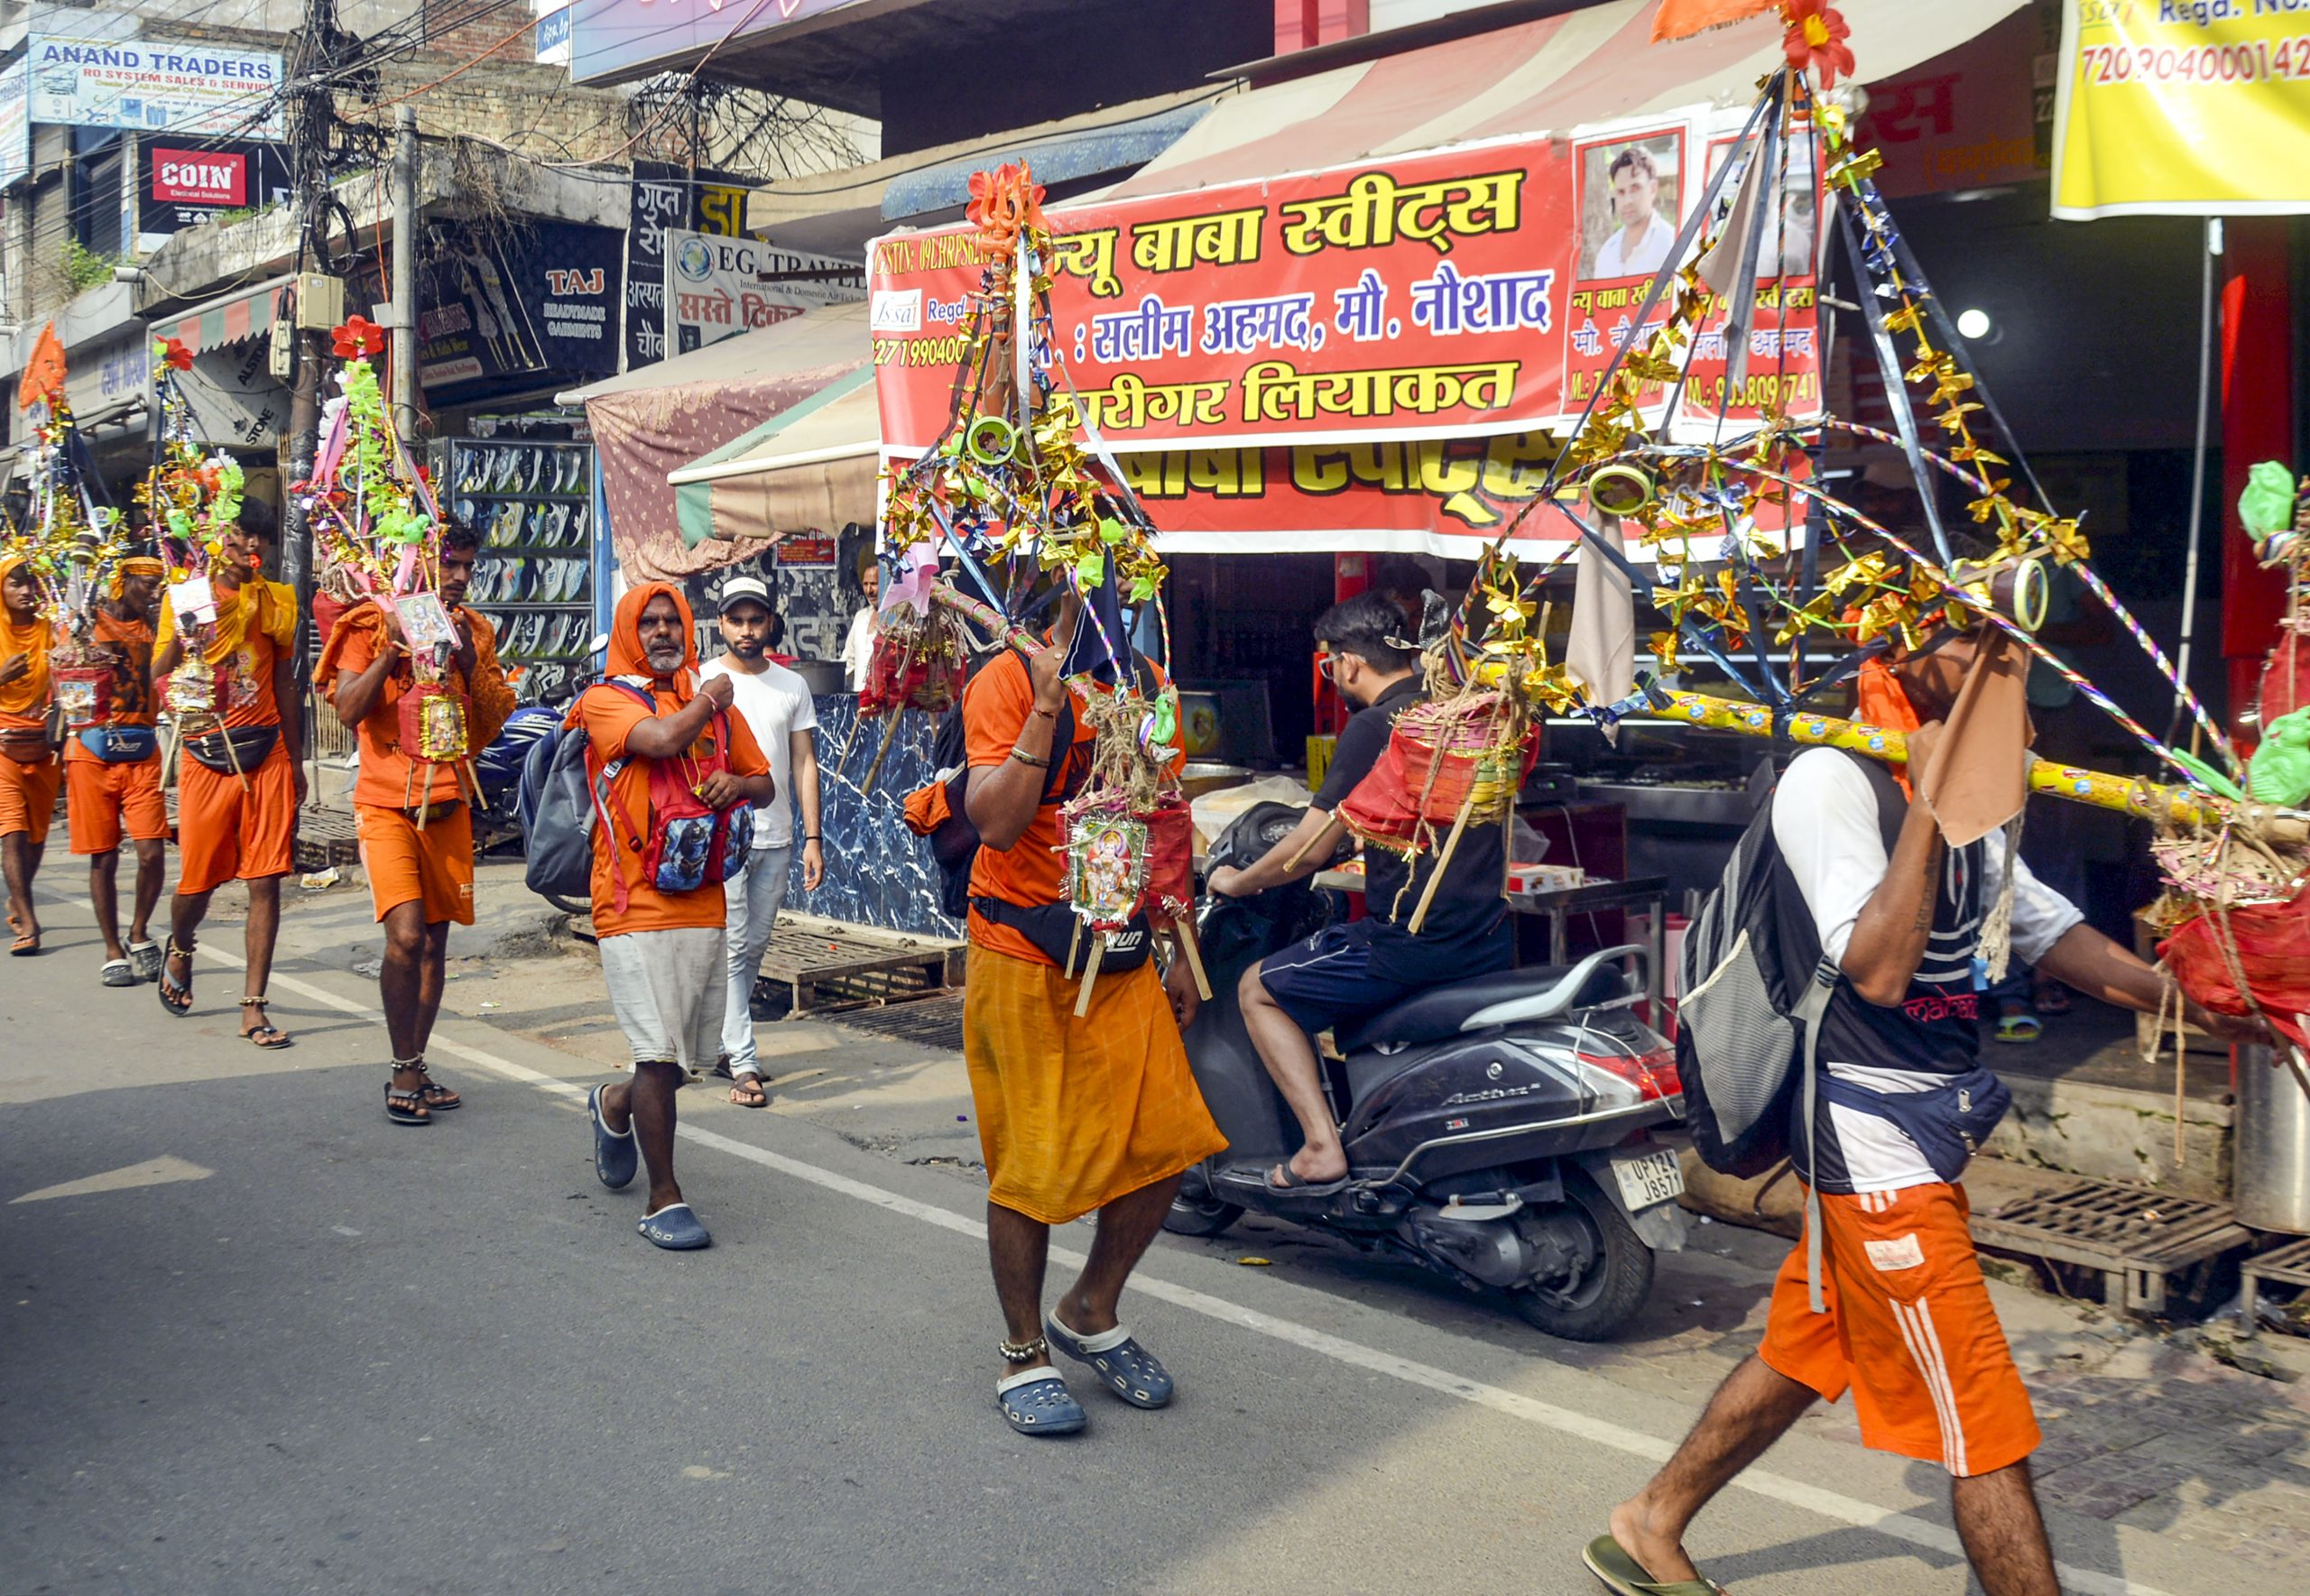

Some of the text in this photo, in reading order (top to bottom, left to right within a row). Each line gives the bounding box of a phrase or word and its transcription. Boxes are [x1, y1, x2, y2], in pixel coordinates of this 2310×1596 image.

[43, 44, 140, 68] ANAND
[149, 53, 273, 79] TRADERS
[106, 69, 161, 83] SYSTEM
[165, 74, 205, 87] SALES
[162, 161, 232, 190] COIN
[201, 190, 231, 200] Solutions
[638, 182, 682, 221] गुप्त
[1130, 205, 1266, 273] बाबा
[1280, 168, 1527, 254] स्वीट्स
[874, 241, 915, 275] GSTIN:
[546, 268, 605, 295] TAJ
[794, 286, 826, 300] Domestic
[543, 302, 606, 322] READYMADE
[678, 288, 734, 326] सस्ते
[1092, 293, 1193, 363] सलीम
[1201, 293, 1326, 356] अहमद,
[1335, 268, 1400, 342] मौ.
[1411, 260, 1557, 337] नौशाद
[547, 323, 602, 340] GARMENTS
[1242, 360, 1522, 423] लियाकत
